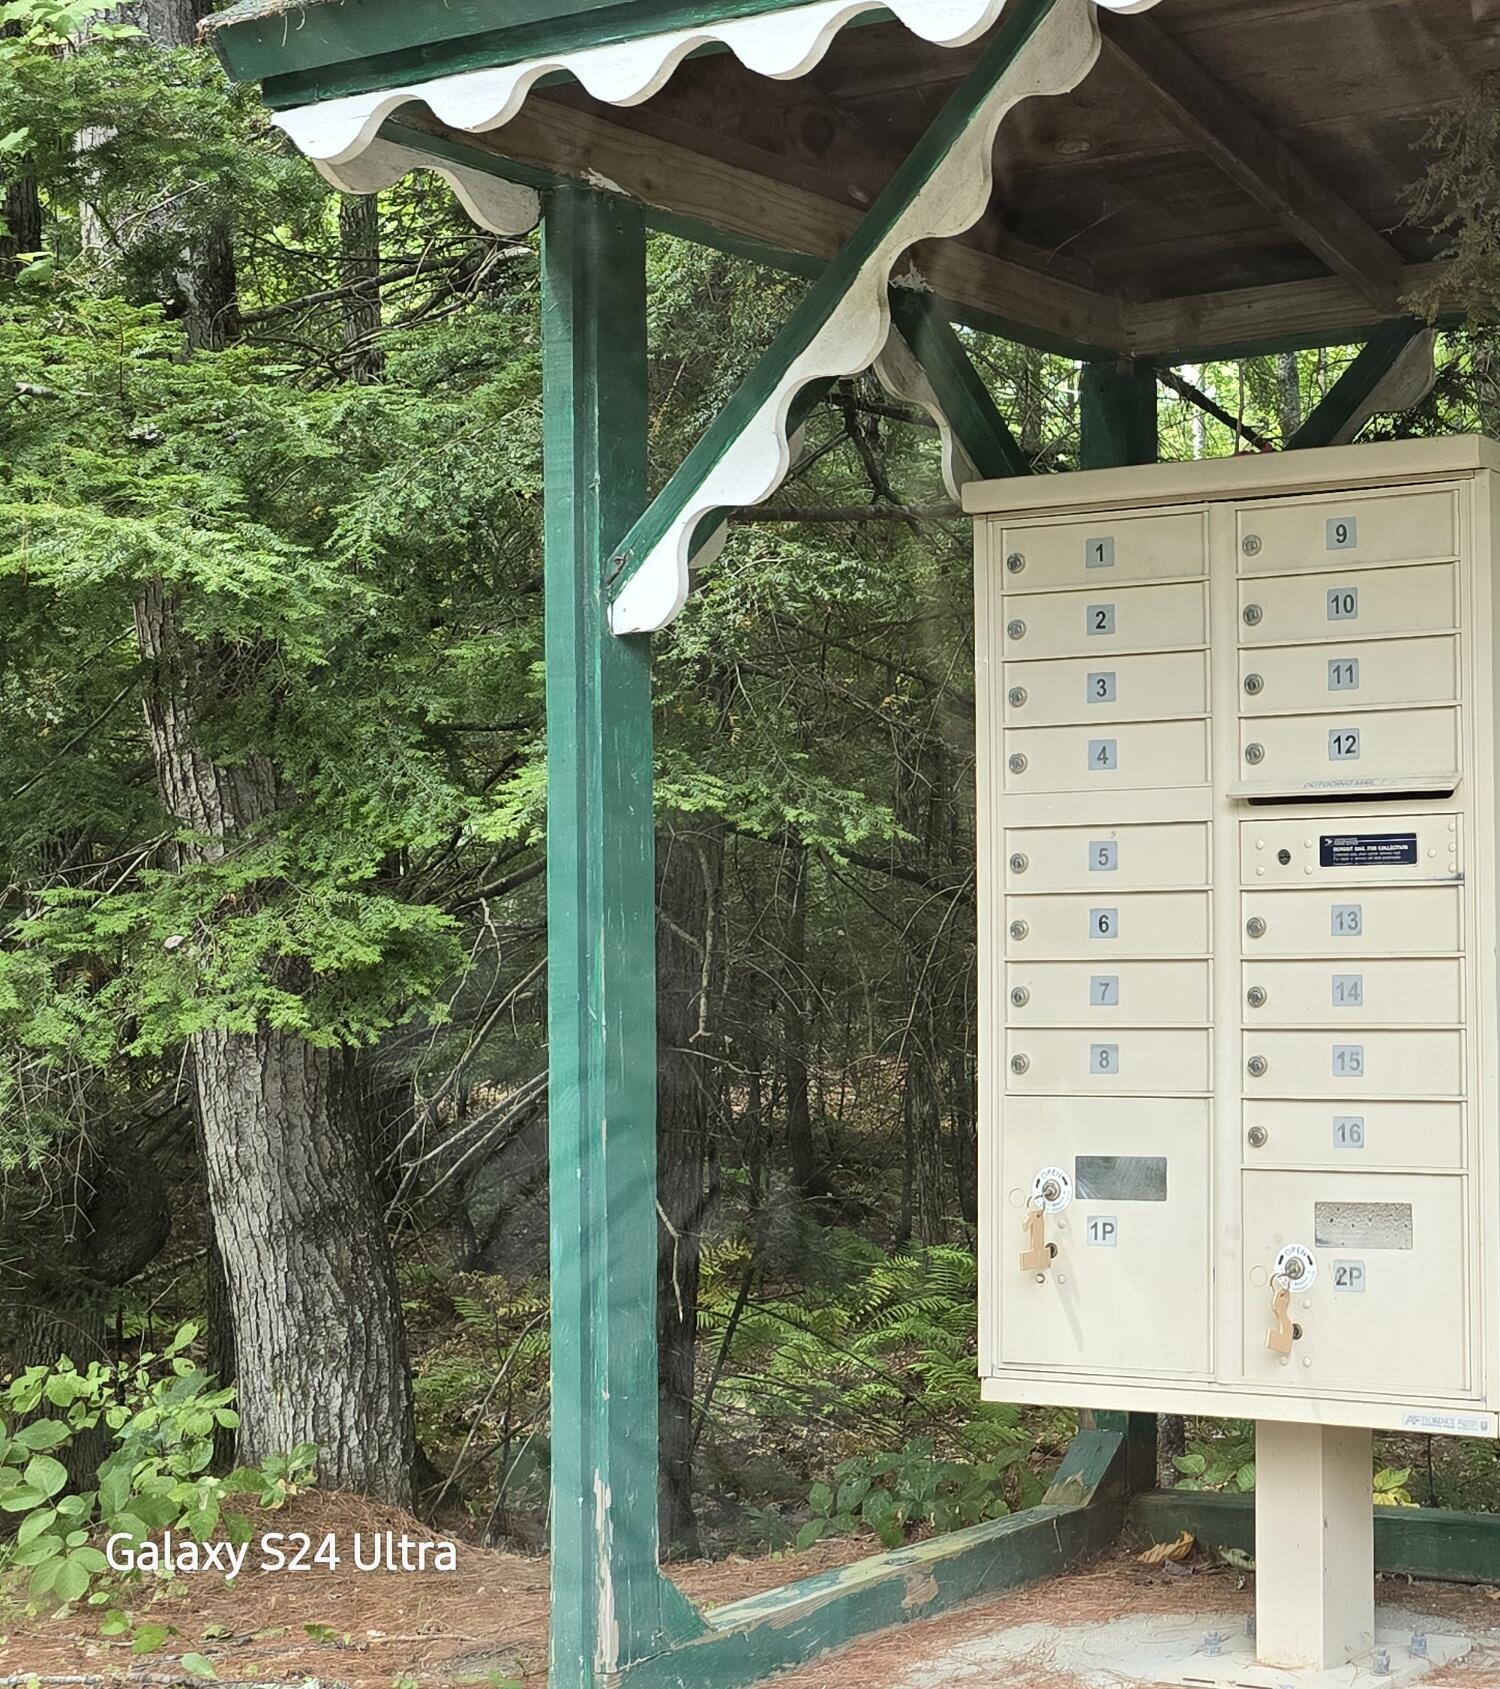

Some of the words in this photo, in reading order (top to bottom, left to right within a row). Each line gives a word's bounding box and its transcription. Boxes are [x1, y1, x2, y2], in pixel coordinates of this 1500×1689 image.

[1335, 523, 1348, 544] 9
[1095, 543, 1104, 562] 1
[1330, 594, 1355, 615] 10
[1095, 610, 1106, 630] 2
[1332, 664, 1354, 685] 11
[1096, 678, 1107, 698] 3
[1333, 734, 1357, 755] 12
[1096, 745, 1109, 765] 4
[1098, 847, 1109, 866] 5
[1098, 914, 1109, 933] 6
[1335, 911, 1359, 931] 13
[1099, 982, 1110, 1001] 7
[1336, 981, 1361, 1002] 14
[1099, 1049, 1110, 1069] 8
[1336, 1051, 1361, 1072] 15
[1337, 1123, 1361, 1143] 16
[1040, 1169, 1062, 1179] OPEN
[1090, 1221, 1115, 1241] 1P
[1284, 1246, 1307, 1257] OPEN
[1335, 1266, 1363, 1287] 2P
